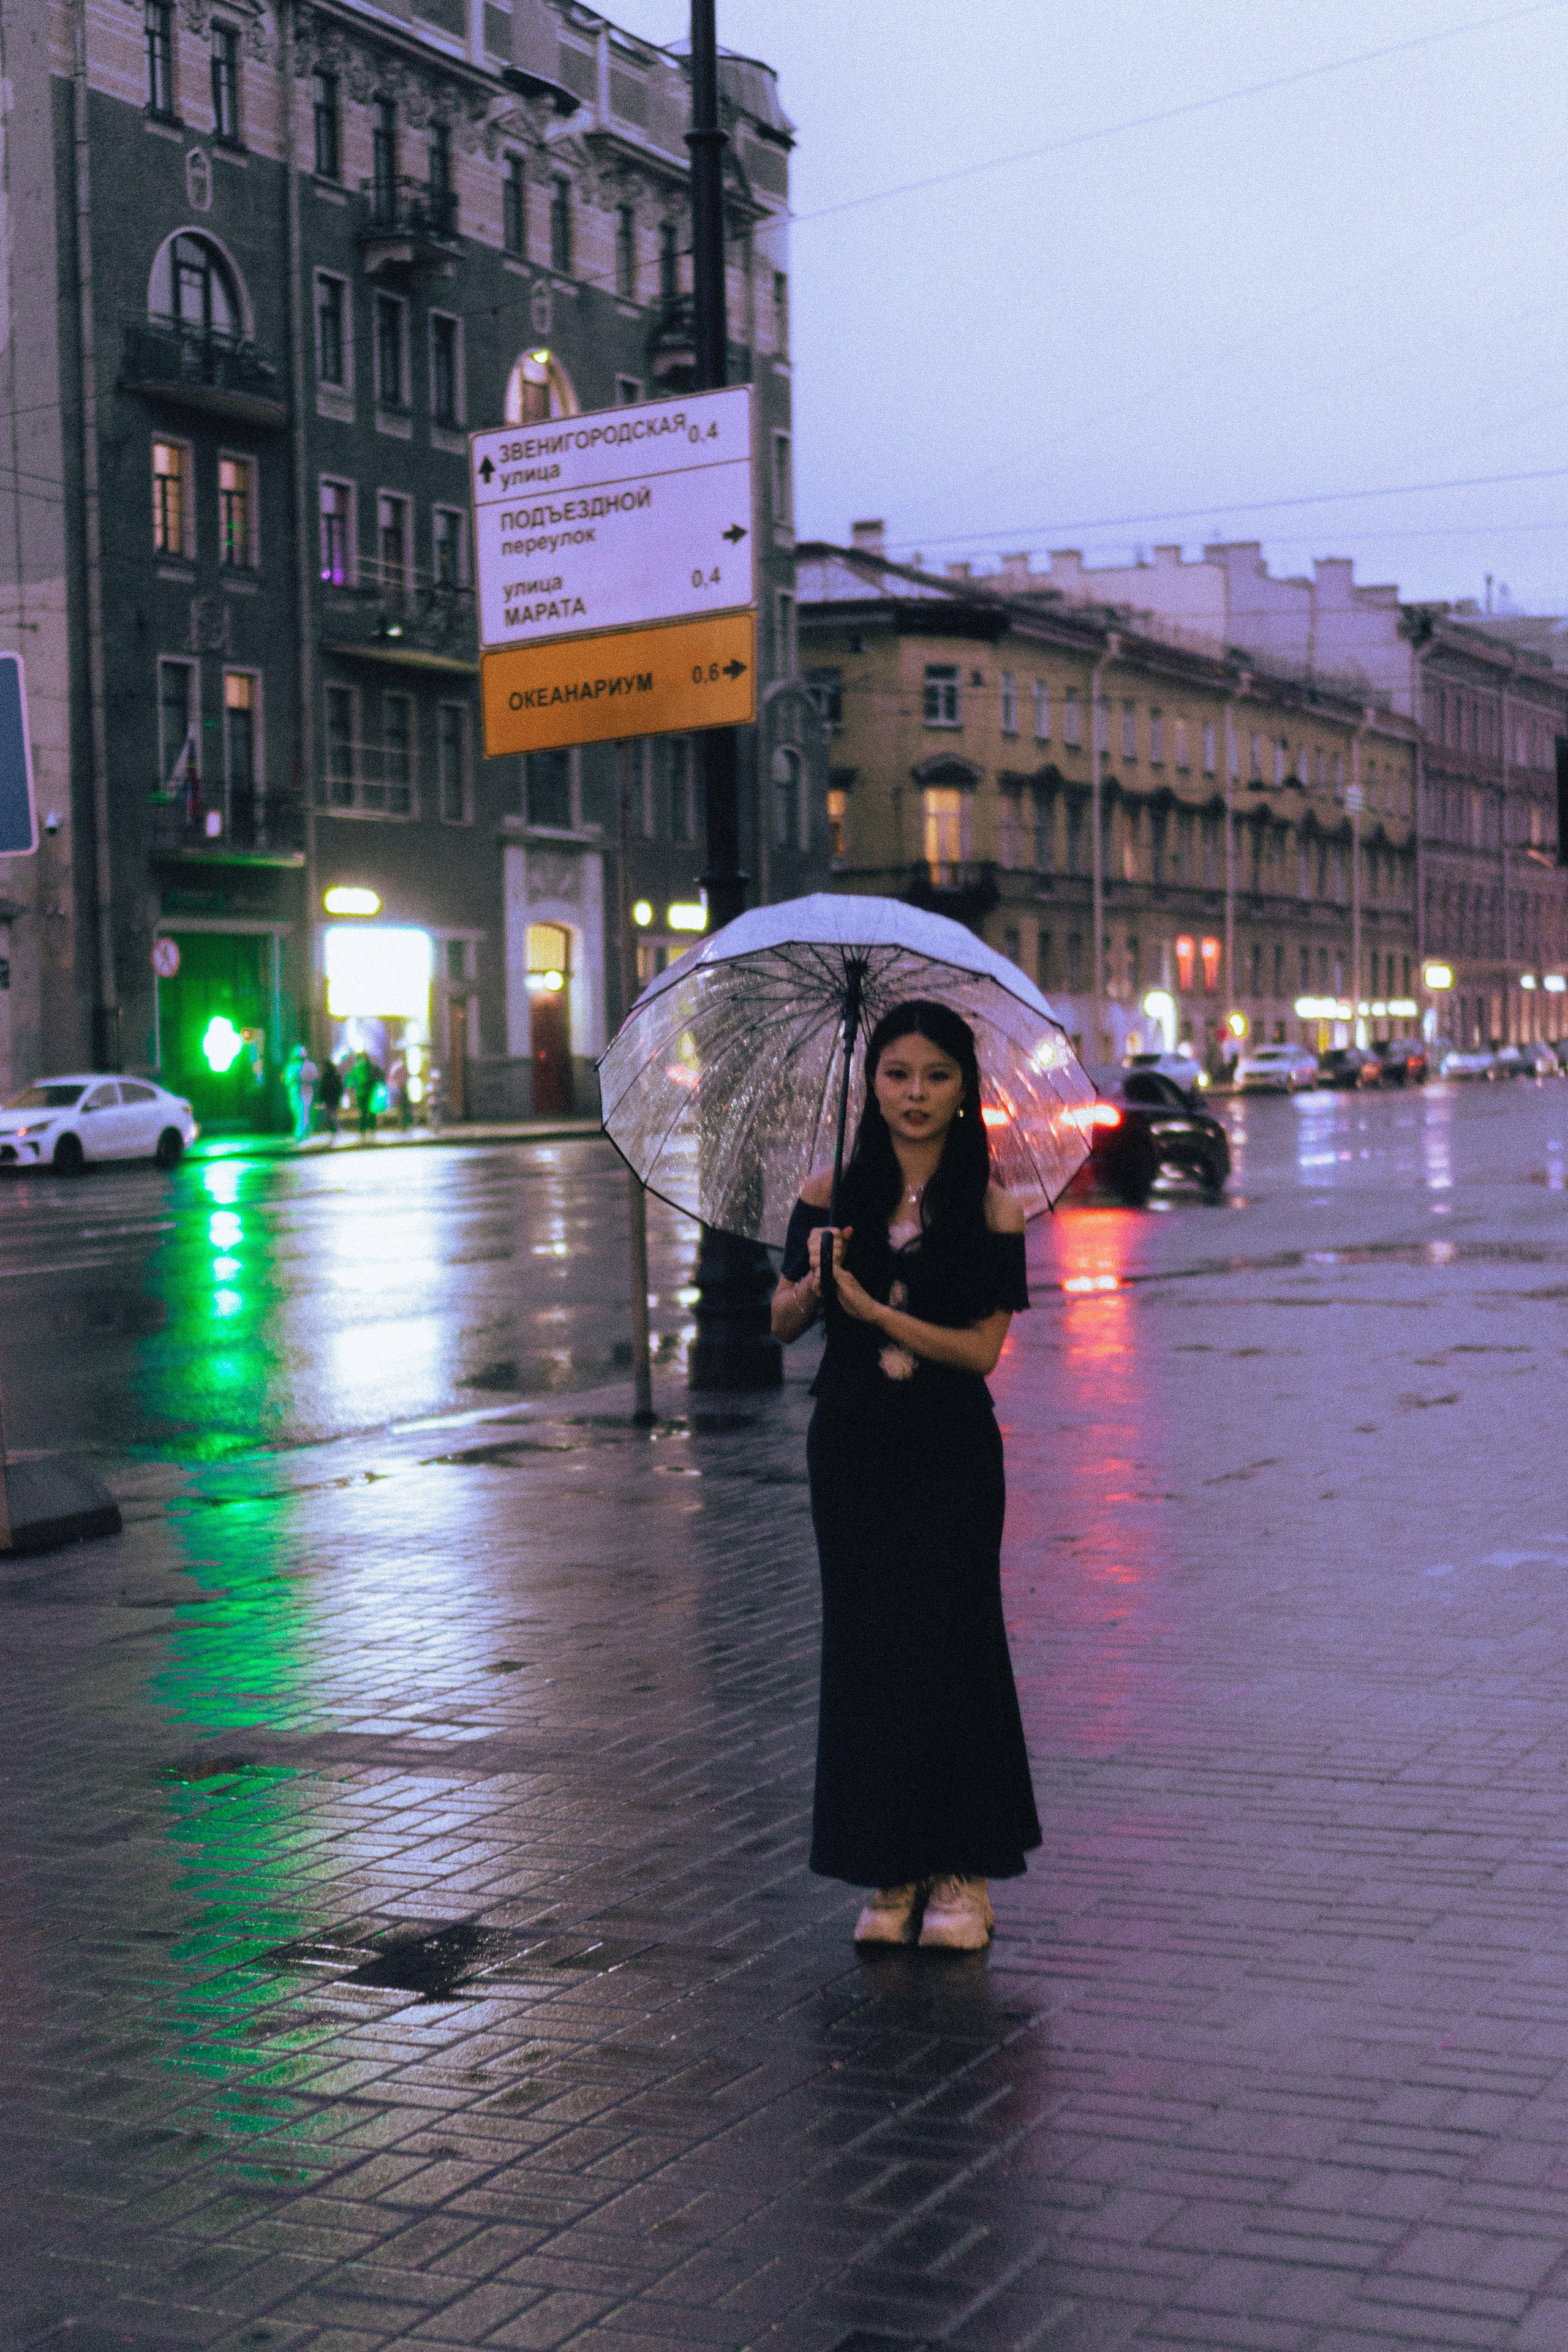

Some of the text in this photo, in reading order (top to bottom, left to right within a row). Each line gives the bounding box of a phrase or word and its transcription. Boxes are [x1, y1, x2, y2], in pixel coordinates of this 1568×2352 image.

[499, 413, 718, 464] ЗВЕНИГОРОДСКАЯ 0,4
[499, 463, 561, 491] улица
[501, 486, 652, 532] ПОДЪЕЗДНОЙ
[502, 528, 596, 556] переулок
[503, 575, 563, 603] улица
[692, 566, 722, 589] 0,4
[504, 597, 586, 627] МАРАТА
[508, 663, 720, 711] ОКЕАНАРИУМ 0,6
